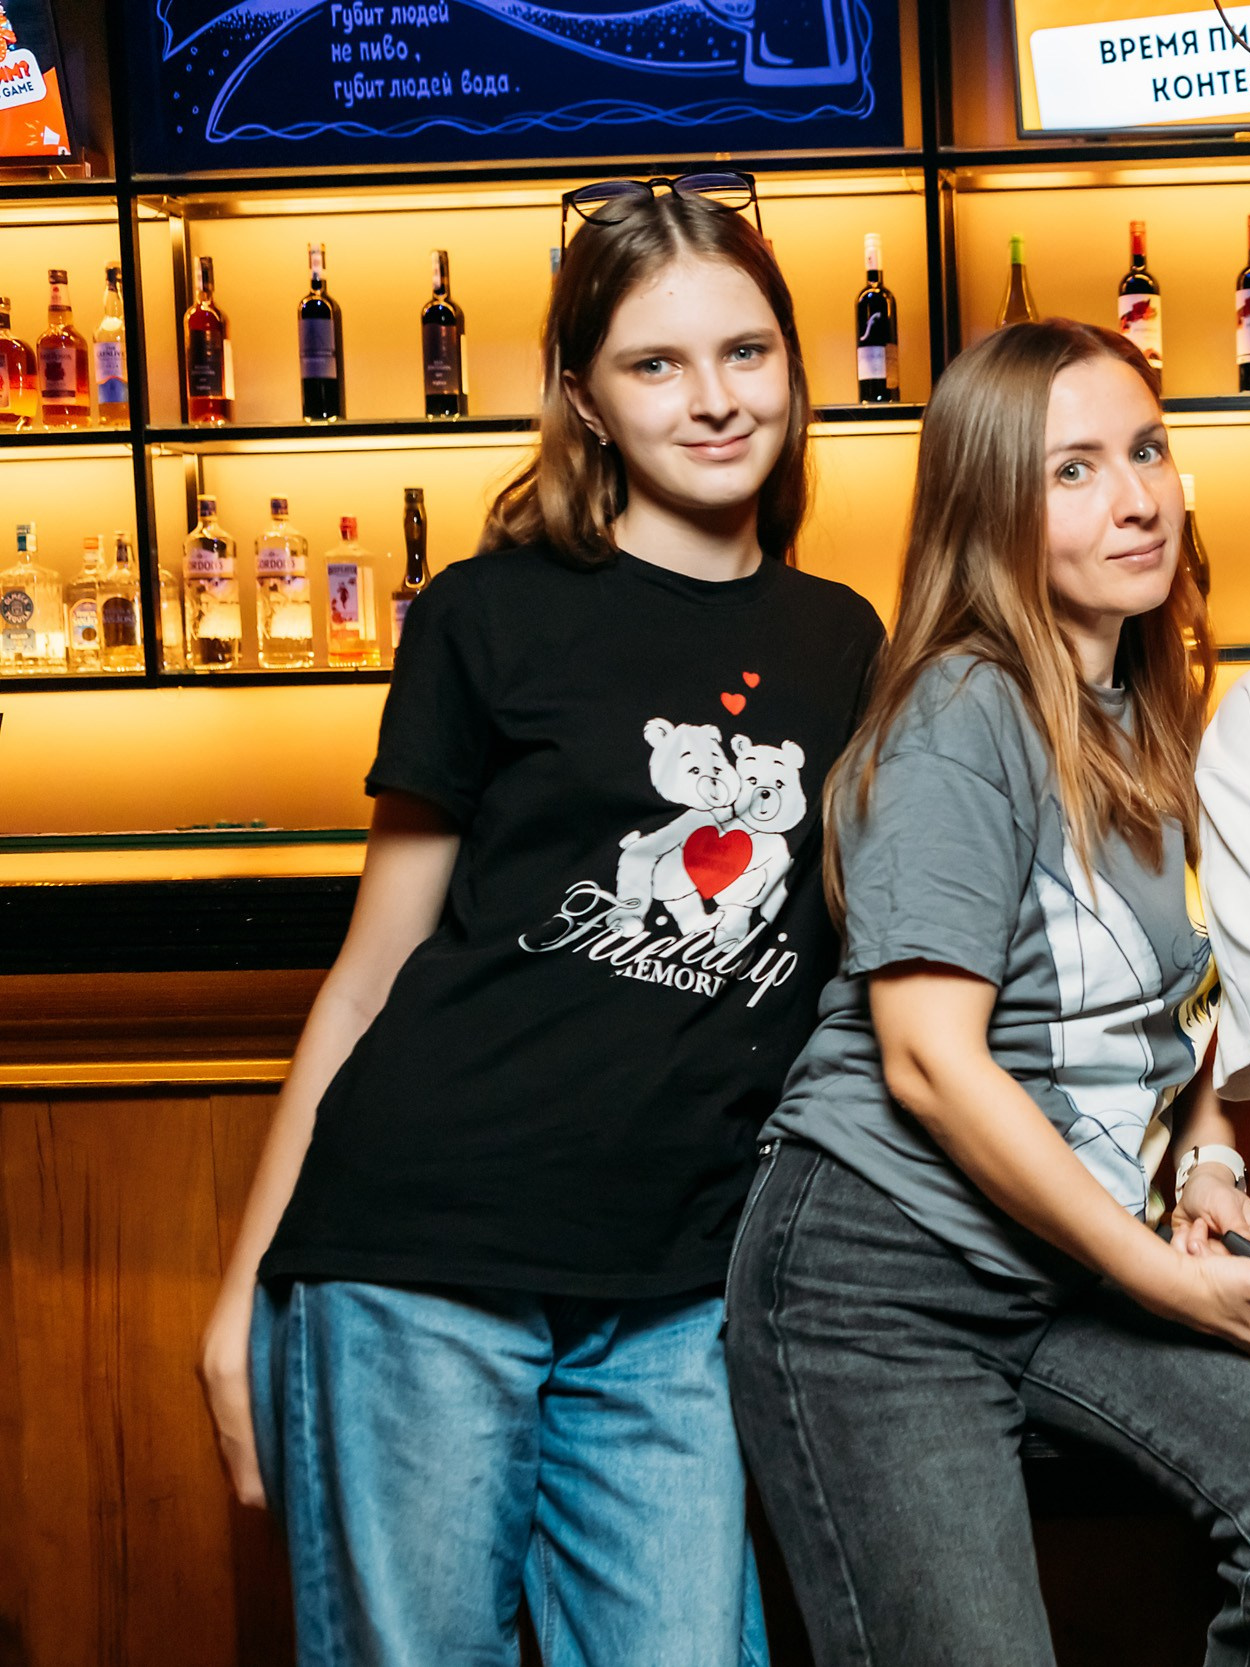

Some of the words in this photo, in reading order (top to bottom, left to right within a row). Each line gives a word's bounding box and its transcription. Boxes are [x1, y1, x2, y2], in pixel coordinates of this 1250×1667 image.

[331, 1, 384, 34] Губит
[390, 0, 449, 27] людей
[331, 42, 352, 63] не
[1100, 30, 1199, 65] ВРЕМЯ
[2, 82, 34, 97] GAME
[333, 72, 384, 107] губит
[389, 72, 452, 99] людей
[517, 879, 799, 1008] Friendip
